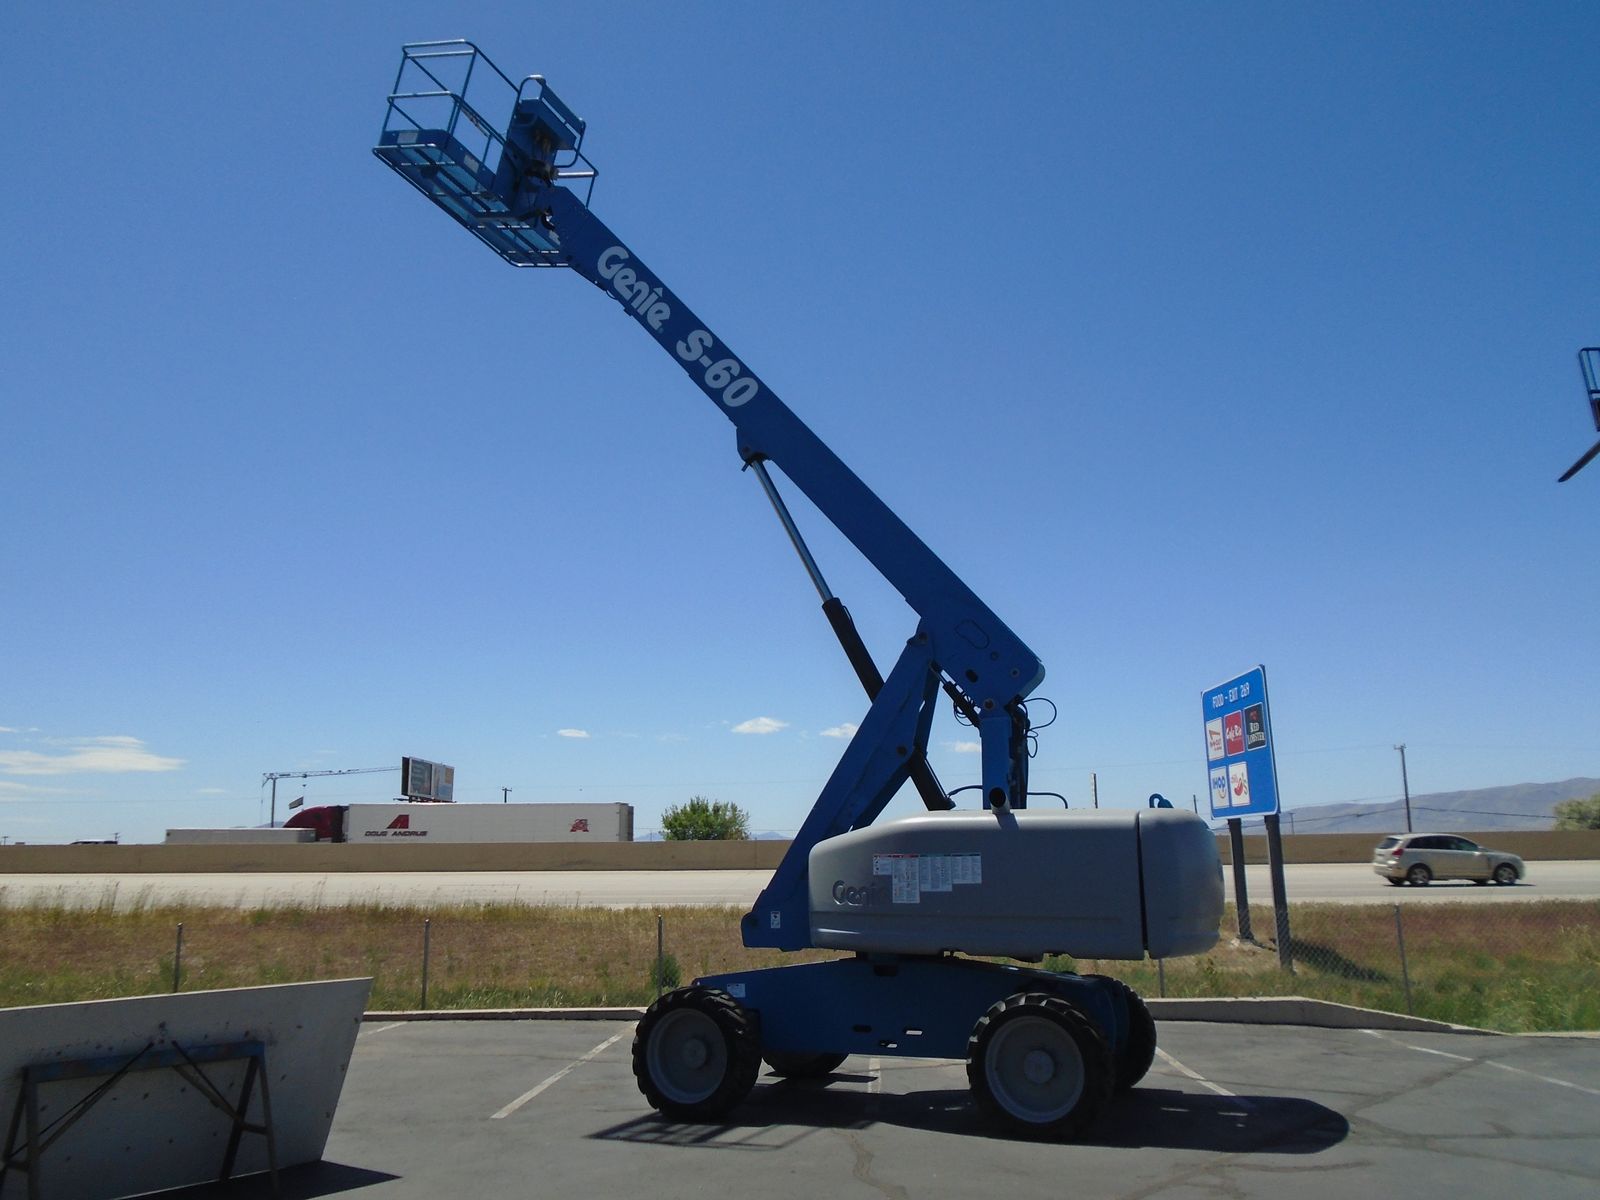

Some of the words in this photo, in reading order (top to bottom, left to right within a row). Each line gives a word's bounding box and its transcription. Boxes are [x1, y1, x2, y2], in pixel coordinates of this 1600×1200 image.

[597, 246, 671, 331] Genie
[676, 329, 759, 407] S-60
[1212, 693, 1225, 709] FOOD
[1228, 687, 1239, 703] EXIT
